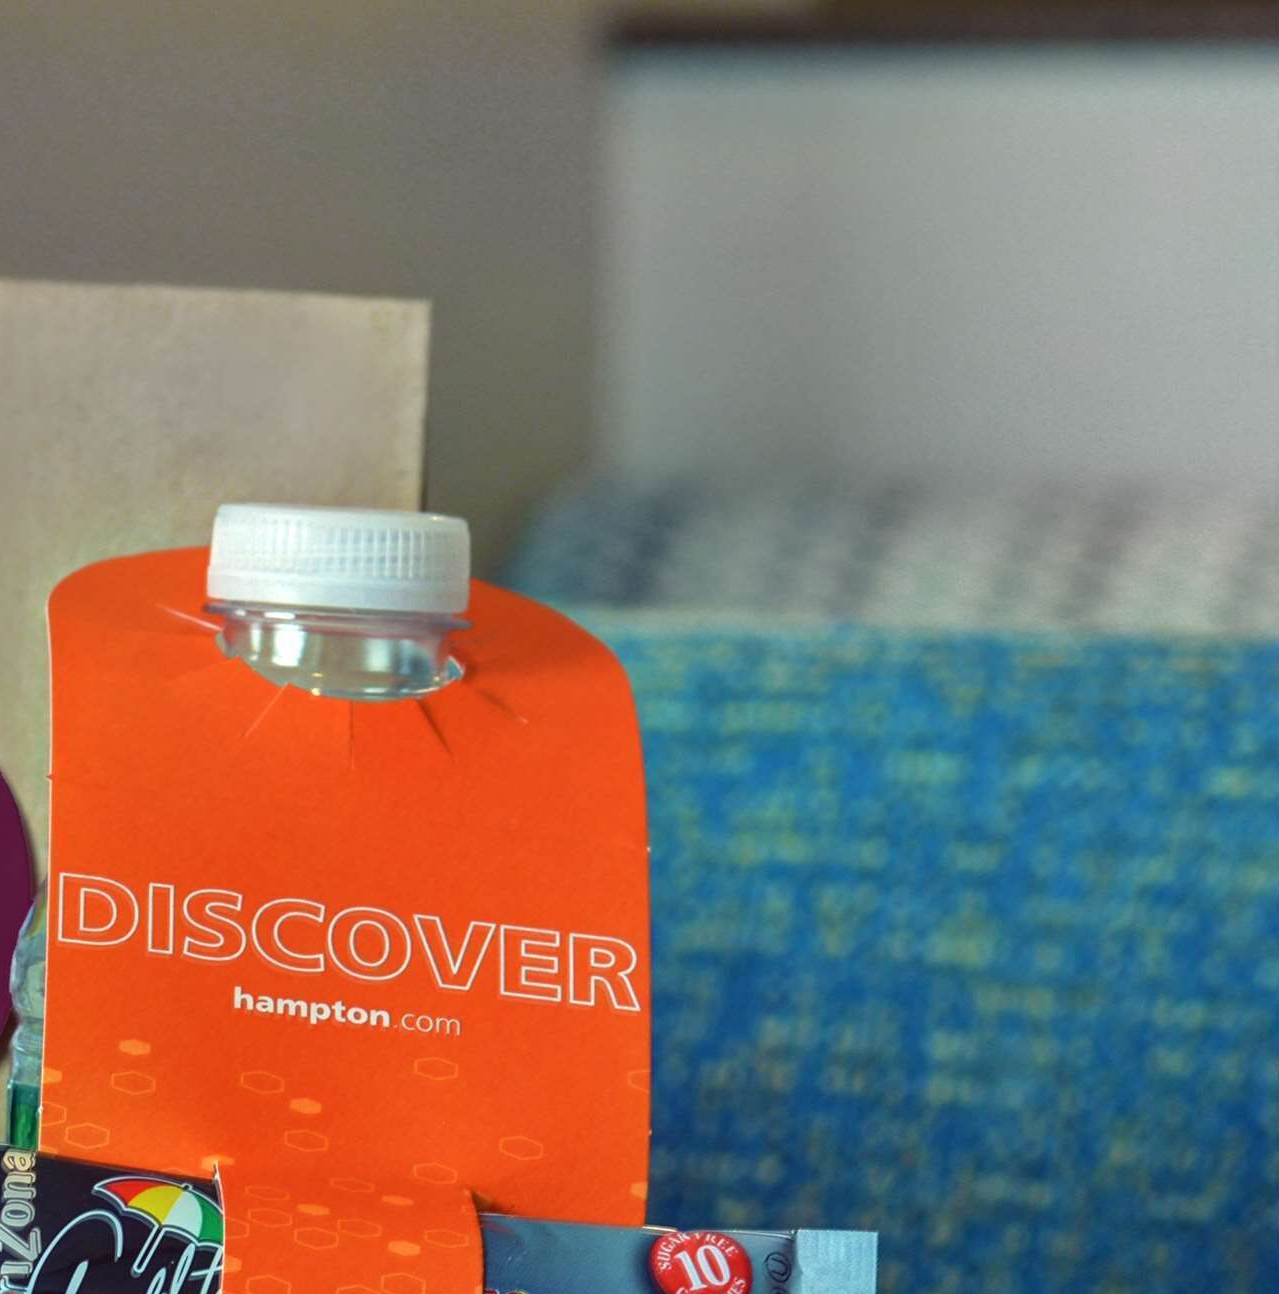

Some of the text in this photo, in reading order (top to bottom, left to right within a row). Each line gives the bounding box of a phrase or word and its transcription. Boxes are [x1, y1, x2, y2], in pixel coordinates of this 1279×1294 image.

[57, 872, 641, 1012] DISCOVER
[233, 986, 462, 1037] hampton.com
[675, 1244, 731, 1292] 10
